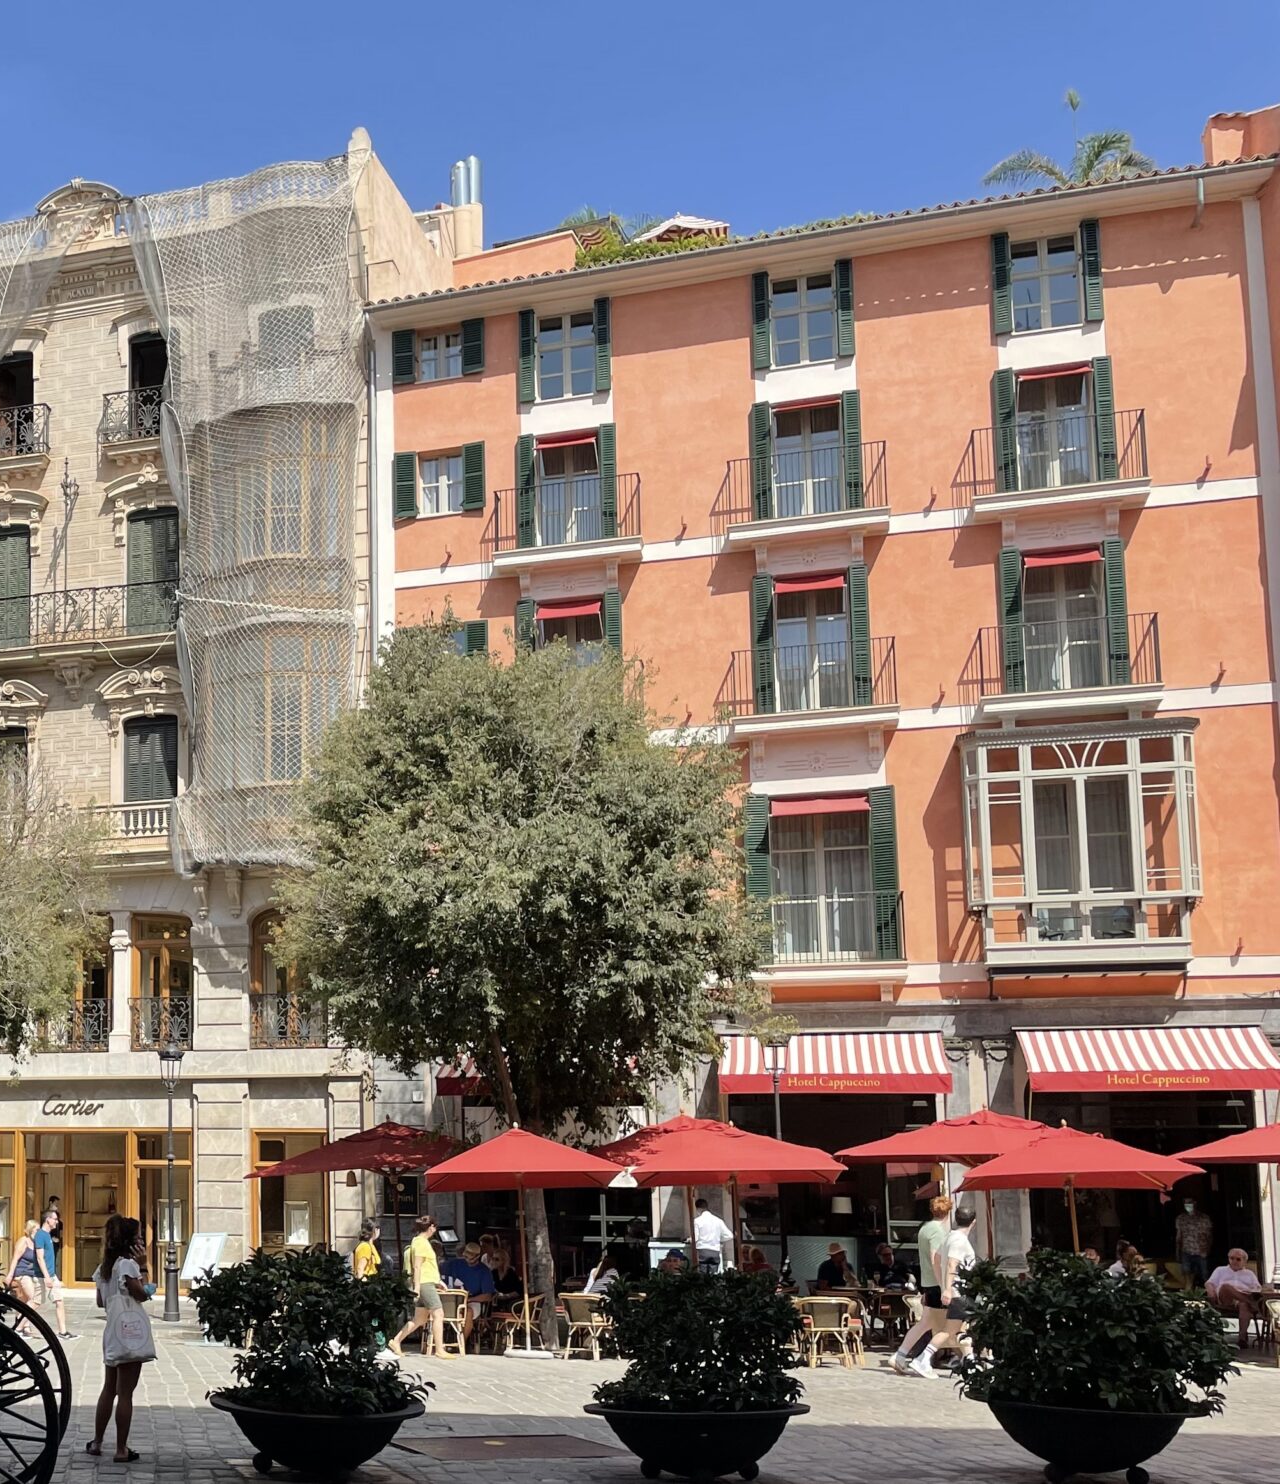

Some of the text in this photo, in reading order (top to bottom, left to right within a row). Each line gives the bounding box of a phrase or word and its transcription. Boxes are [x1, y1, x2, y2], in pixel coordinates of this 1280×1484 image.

[787, 1076, 881, 1090] Hotel Cappuccino
[1107, 1073, 1210, 1088] Hotel Cappuccino
[42, 1094, 104, 1115] Cartier
